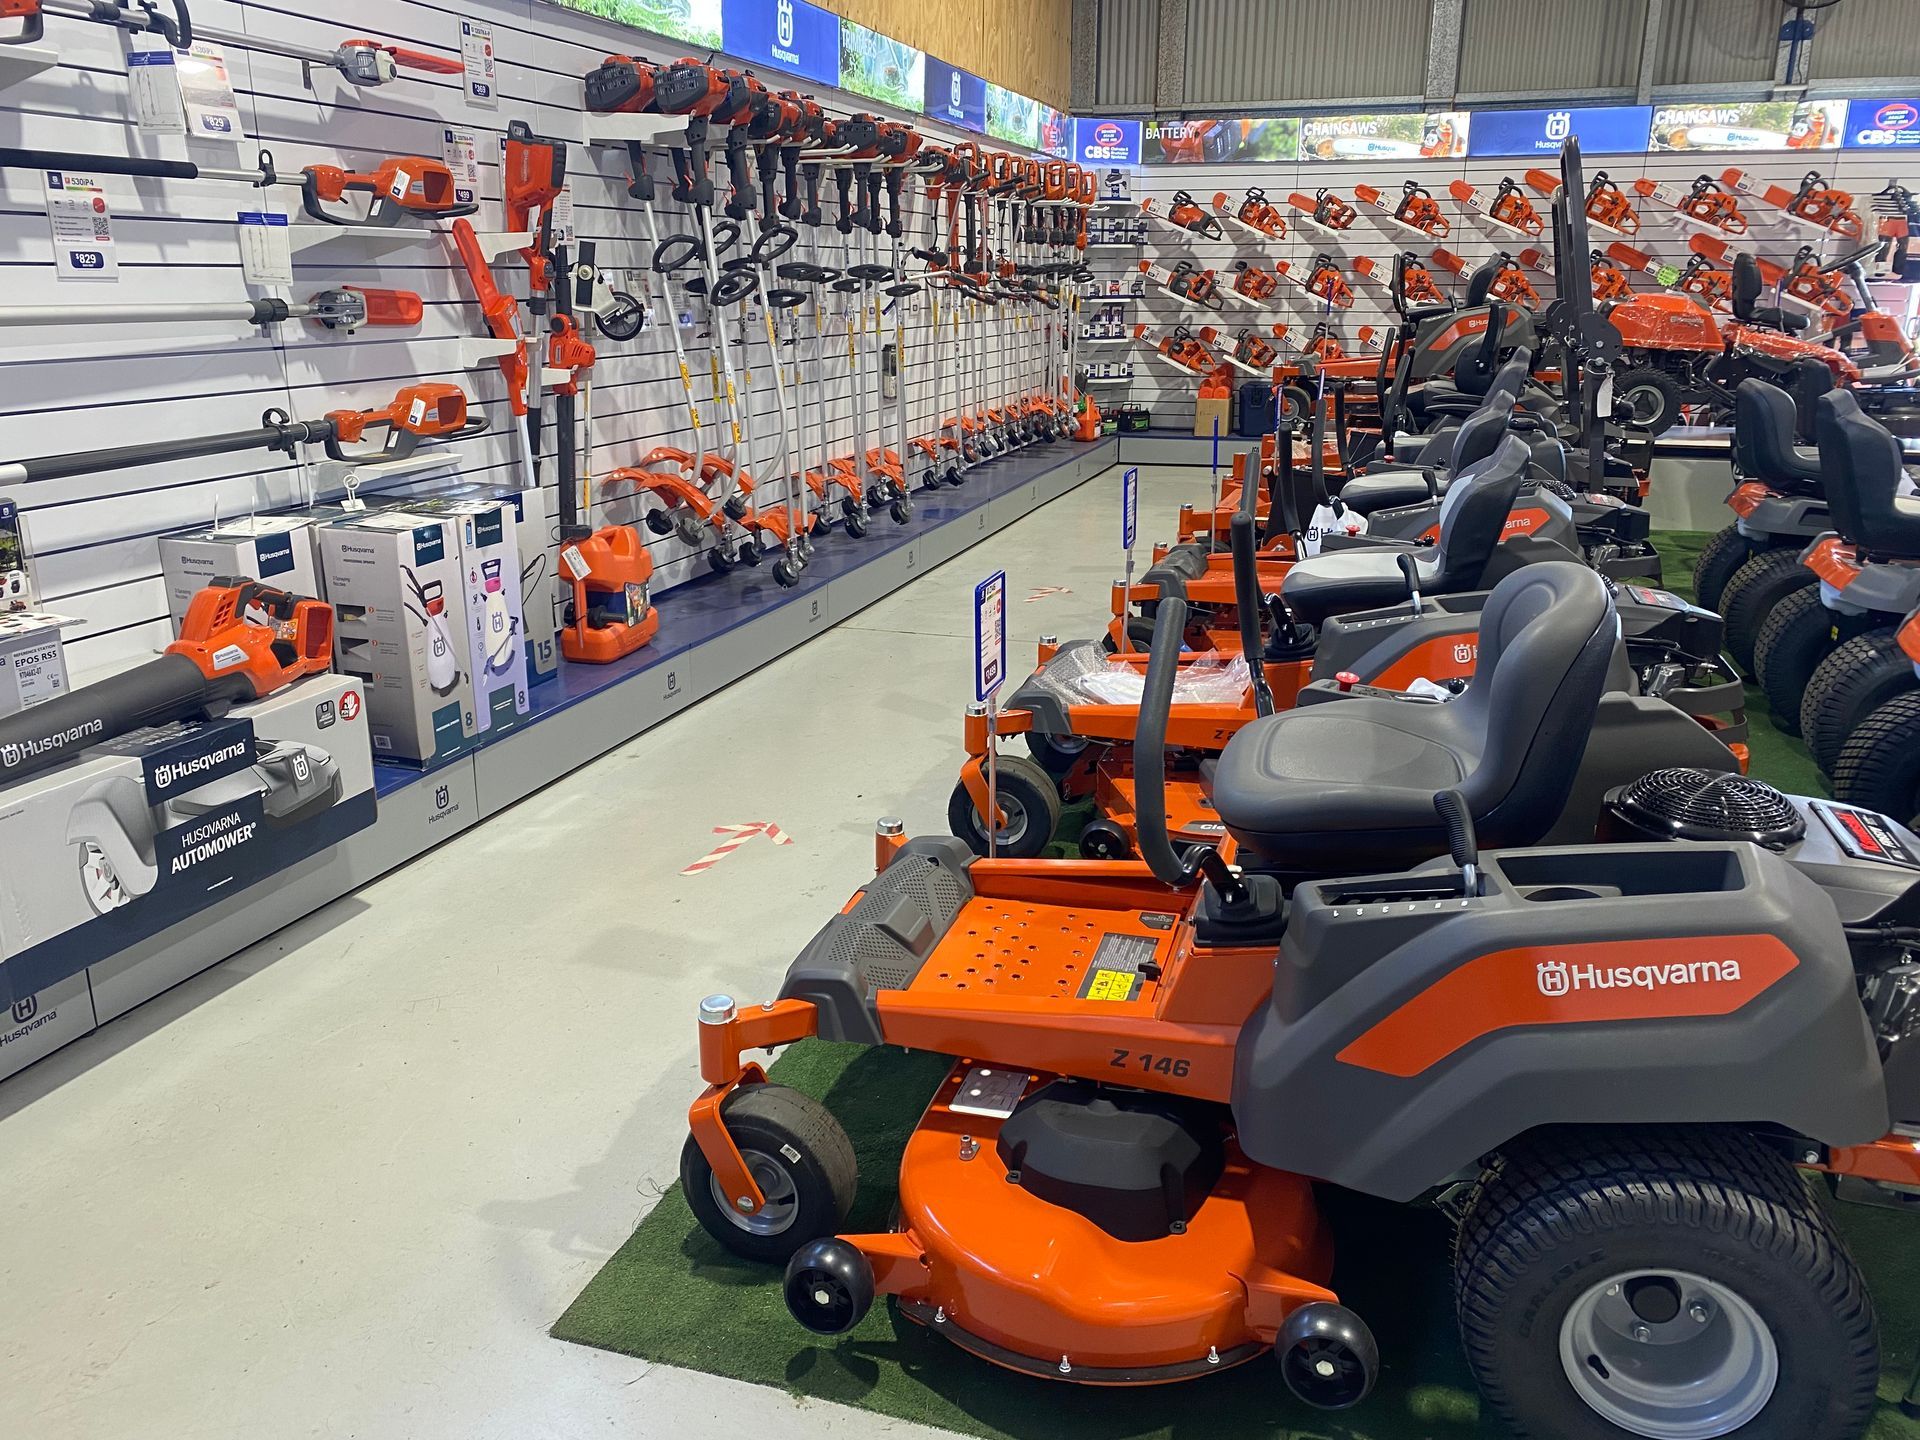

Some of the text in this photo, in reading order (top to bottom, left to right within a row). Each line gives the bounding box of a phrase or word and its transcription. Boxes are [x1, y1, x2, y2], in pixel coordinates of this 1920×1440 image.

[771, 43, 799, 65] Husqvarna
[204, 115, 225, 127] $829
[1655, 109, 1740, 125] CHAINSAWS
[1145, 127, 1195, 140] BATTERY
[1304, 121, 1378, 136] CHAINSAWS
[1858, 129, 1896, 145] CBS
[1084, 145, 1110, 159] CBS
[71, 177, 94, 186] 530iP4
[75, 253, 97, 264] $829
[347, 545, 375, 554] Husqvarna
[420, 538, 441, 549] Husqvarna
[186, 557, 214, 566] Husqvarna
[264, 548, 290, 560] Husqvarna
[537, 639, 552, 660] 15
[15, 655, 39, 668] EPOS
[41, 650, 57, 661] RS5
[518, 690, 525, 705] 8
[465, 712, 473, 727] 8
[19, 719, 103, 759] Husqvarna
[171, 741, 245, 780] Husqvarna
[428, 804, 459, 824] Husqvarna
[181, 812, 241, 848] HUSQVARNA
[1572, 959, 1741, 992] Husqvarna
[0, 1010, 57, 1047] Husqvarna
[1110, 1049, 1191, 1078] Z 146
